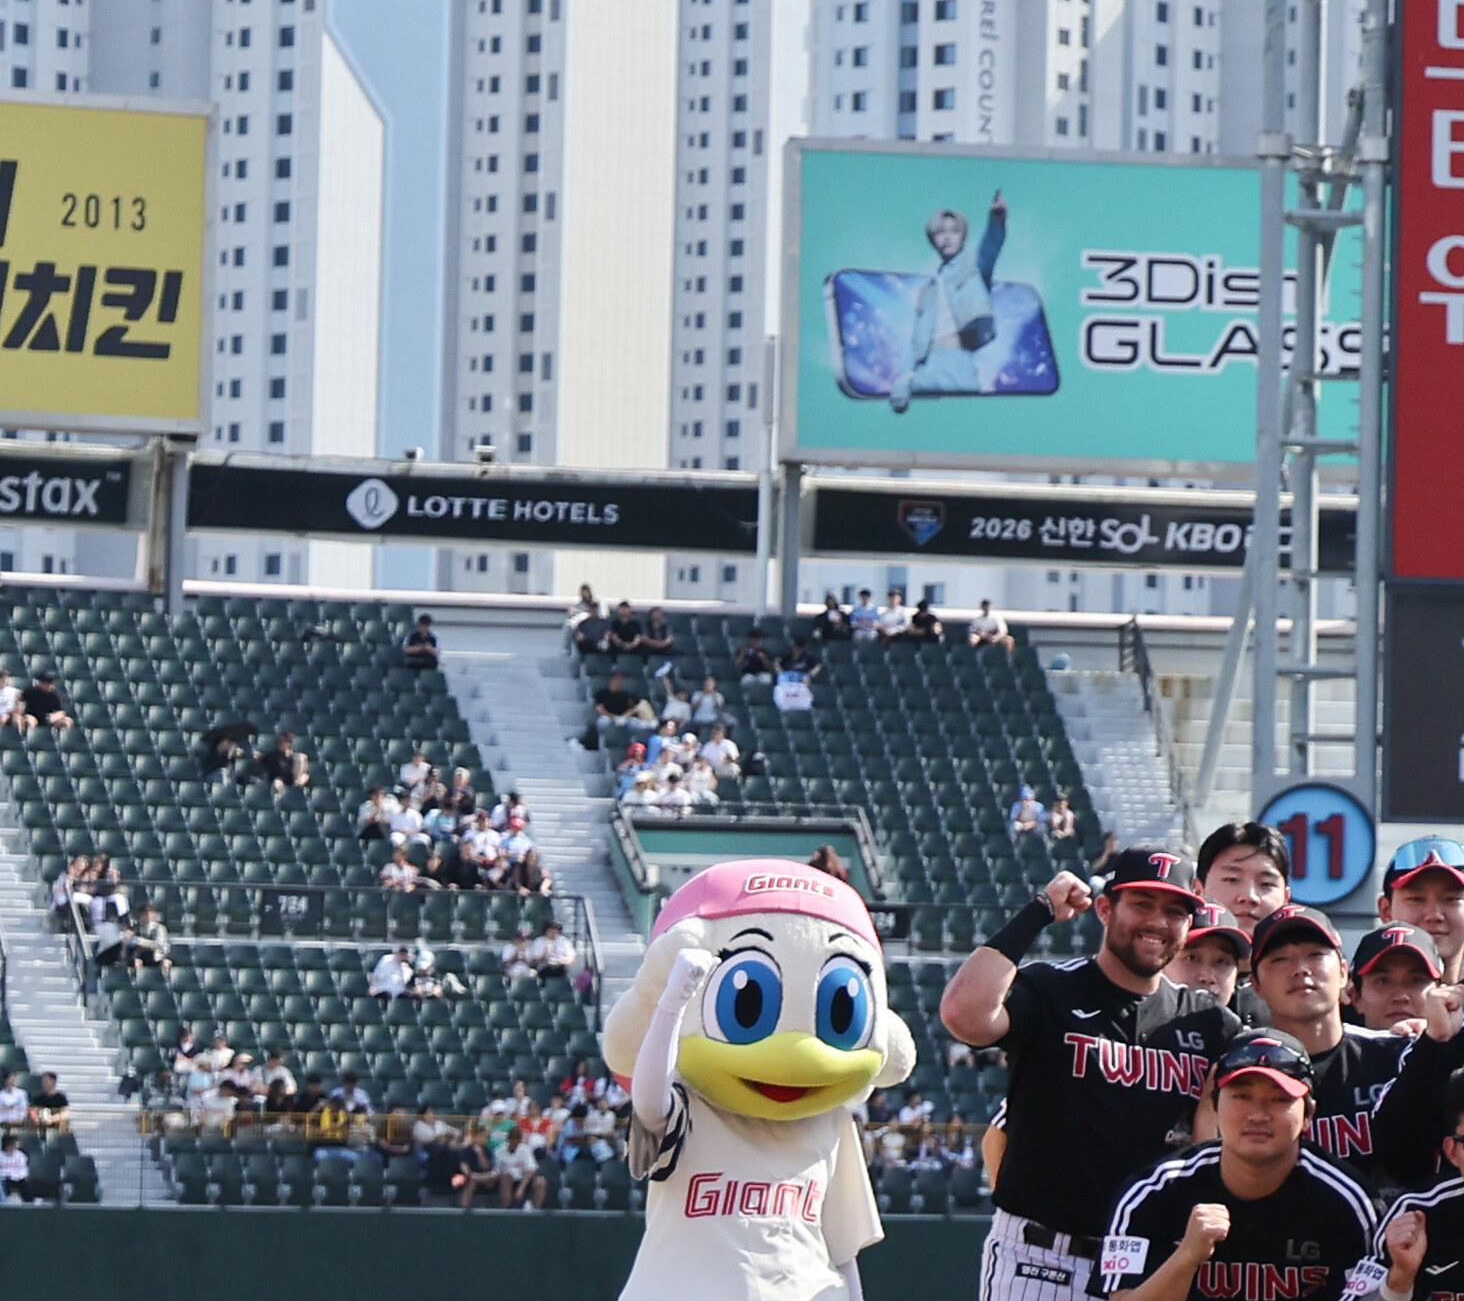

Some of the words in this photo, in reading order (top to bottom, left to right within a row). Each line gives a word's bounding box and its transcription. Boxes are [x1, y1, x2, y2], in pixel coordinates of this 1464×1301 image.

[61, 193, 147, 232] 2013
[0, 260, 184, 360] 치킨
[407, 495, 508, 521] LOTTE
[513, 500, 621, 525] HOTELS
[969, 516, 1031, 540] 2026
[1279, 812, 1344, 880] 11
[1175, 1029, 1205, 1049] LG
[1064, 1032, 1210, 1098] TWINS
[1286, 1239, 1320, 1260] LG
[1197, 1261, 1330, 1301] WINS
